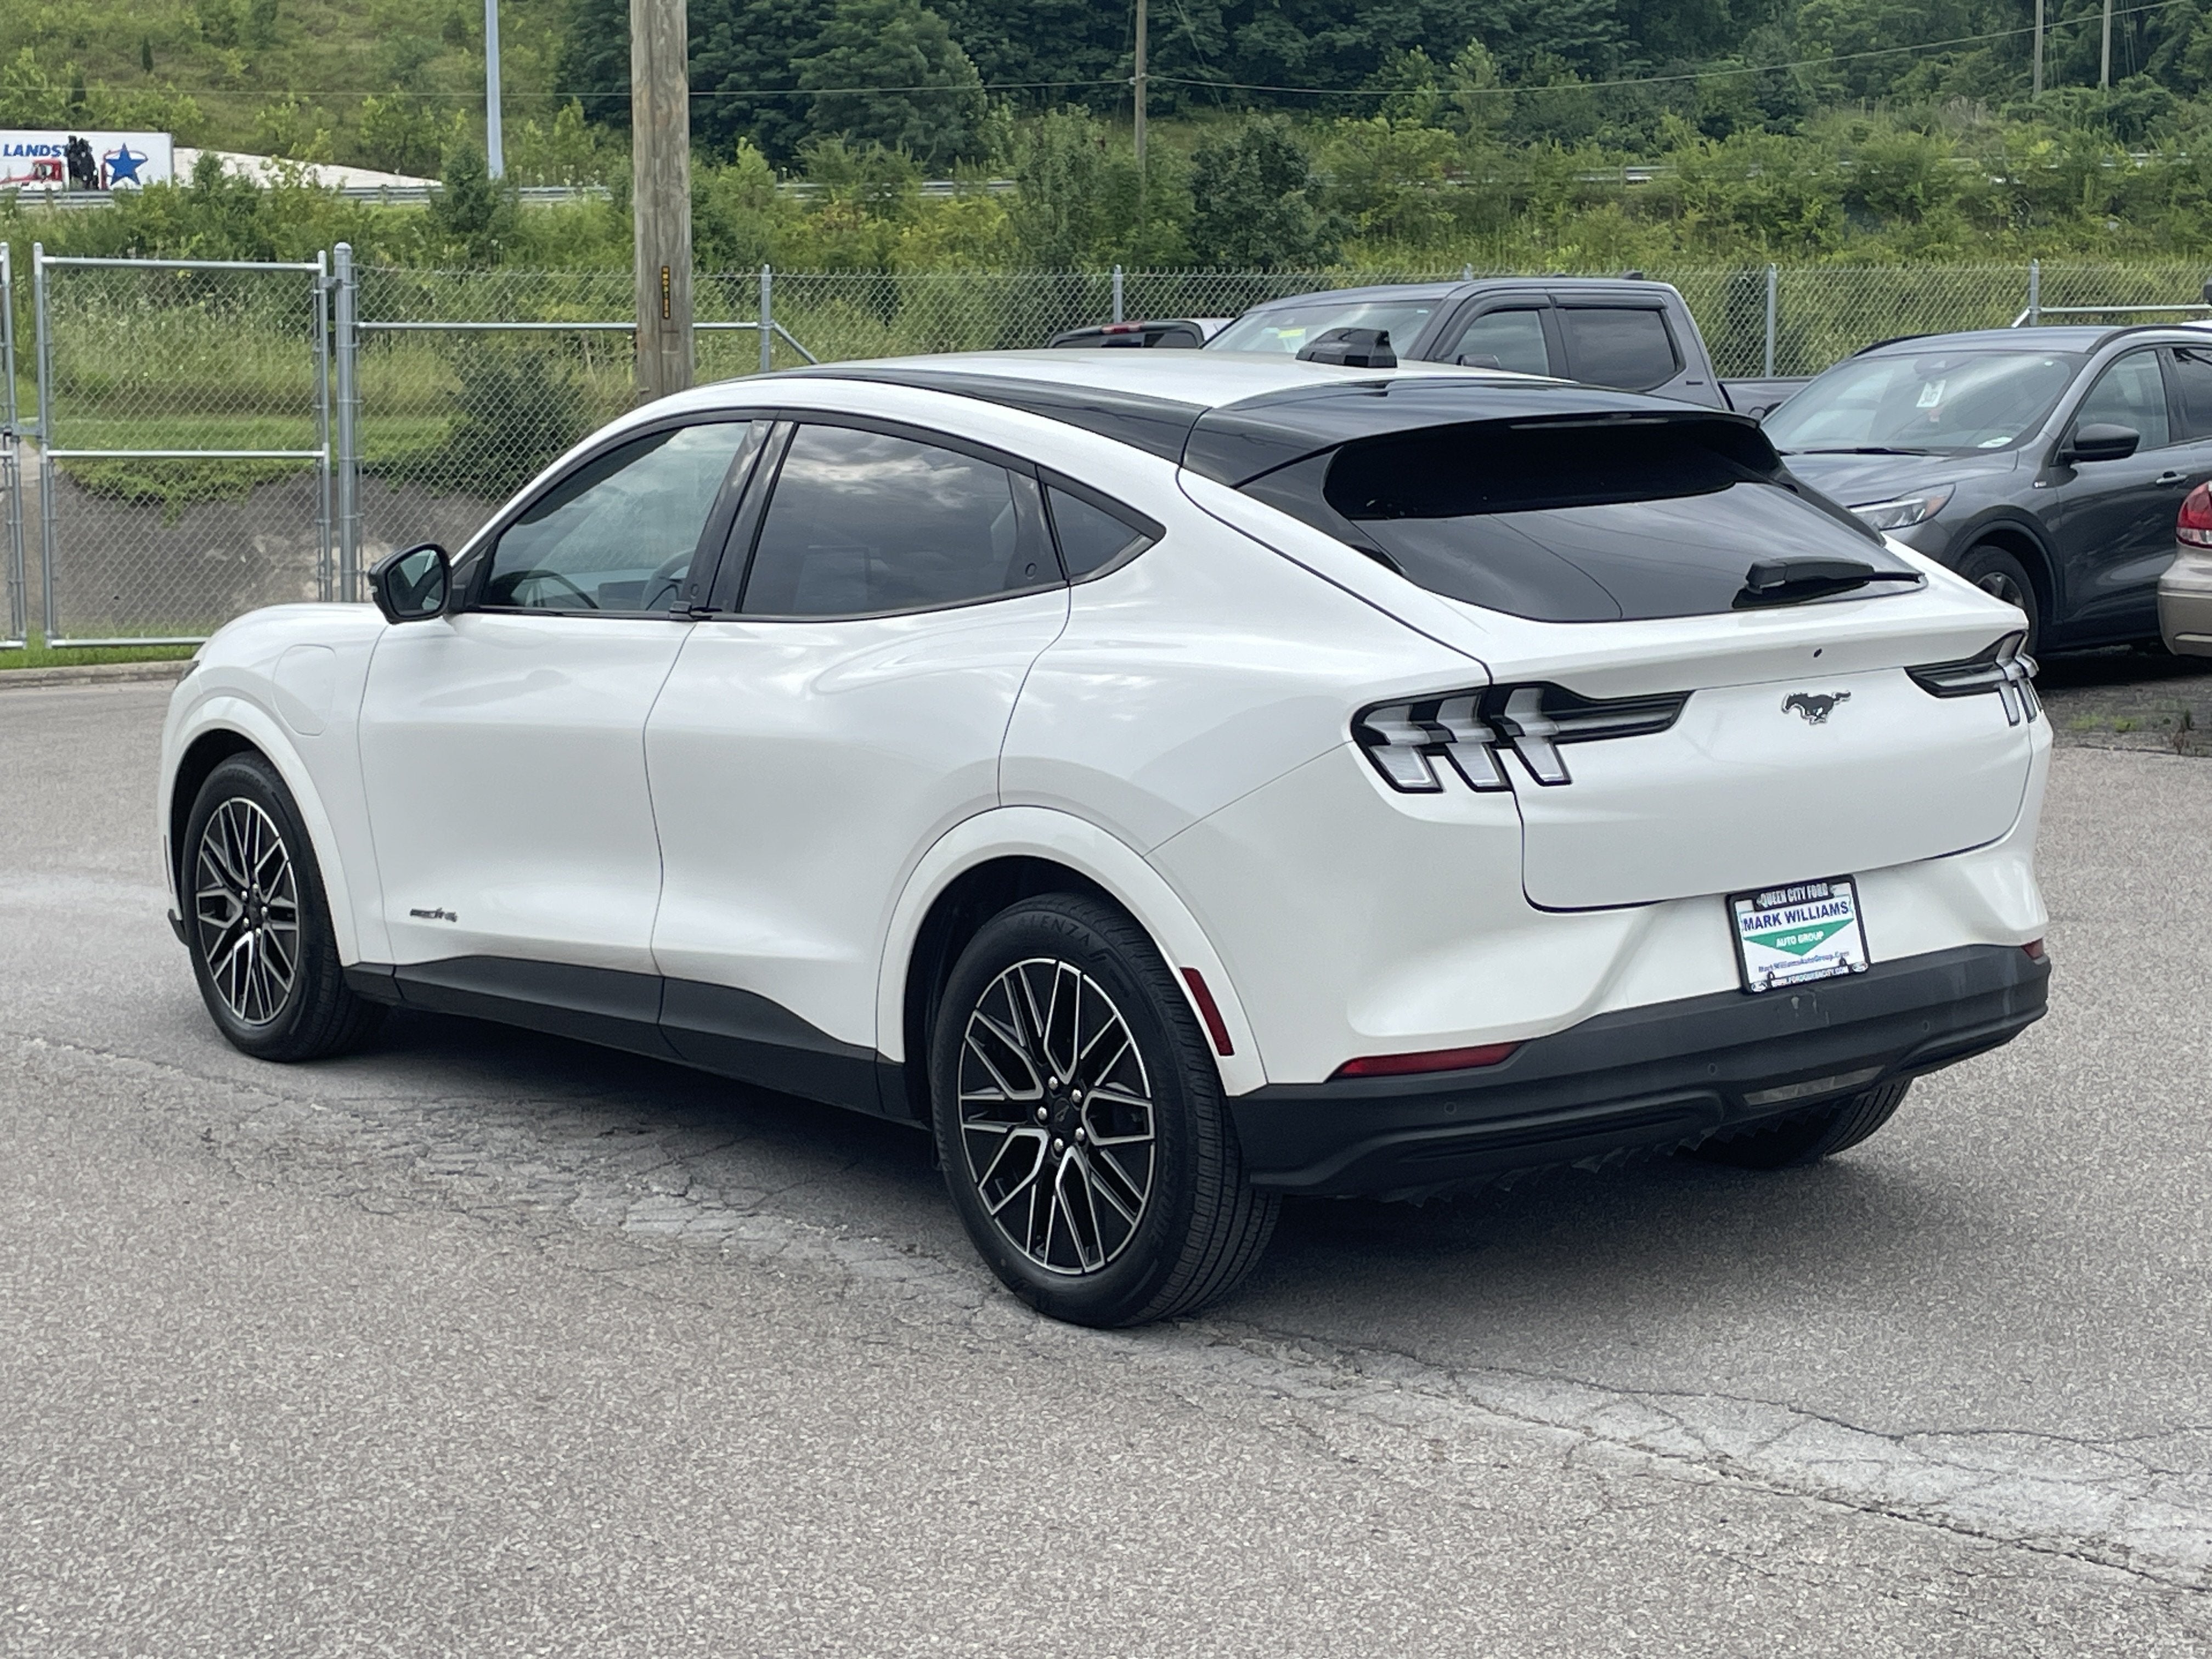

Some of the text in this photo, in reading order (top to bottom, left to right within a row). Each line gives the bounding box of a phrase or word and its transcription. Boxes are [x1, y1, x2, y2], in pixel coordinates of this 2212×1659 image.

[1760, 882, 1829, 908] QUEEN CITY FORD
[1743, 901, 1849, 932] MARK WILLIAMS
[1776, 931, 1824, 947] AUTO GROUP
